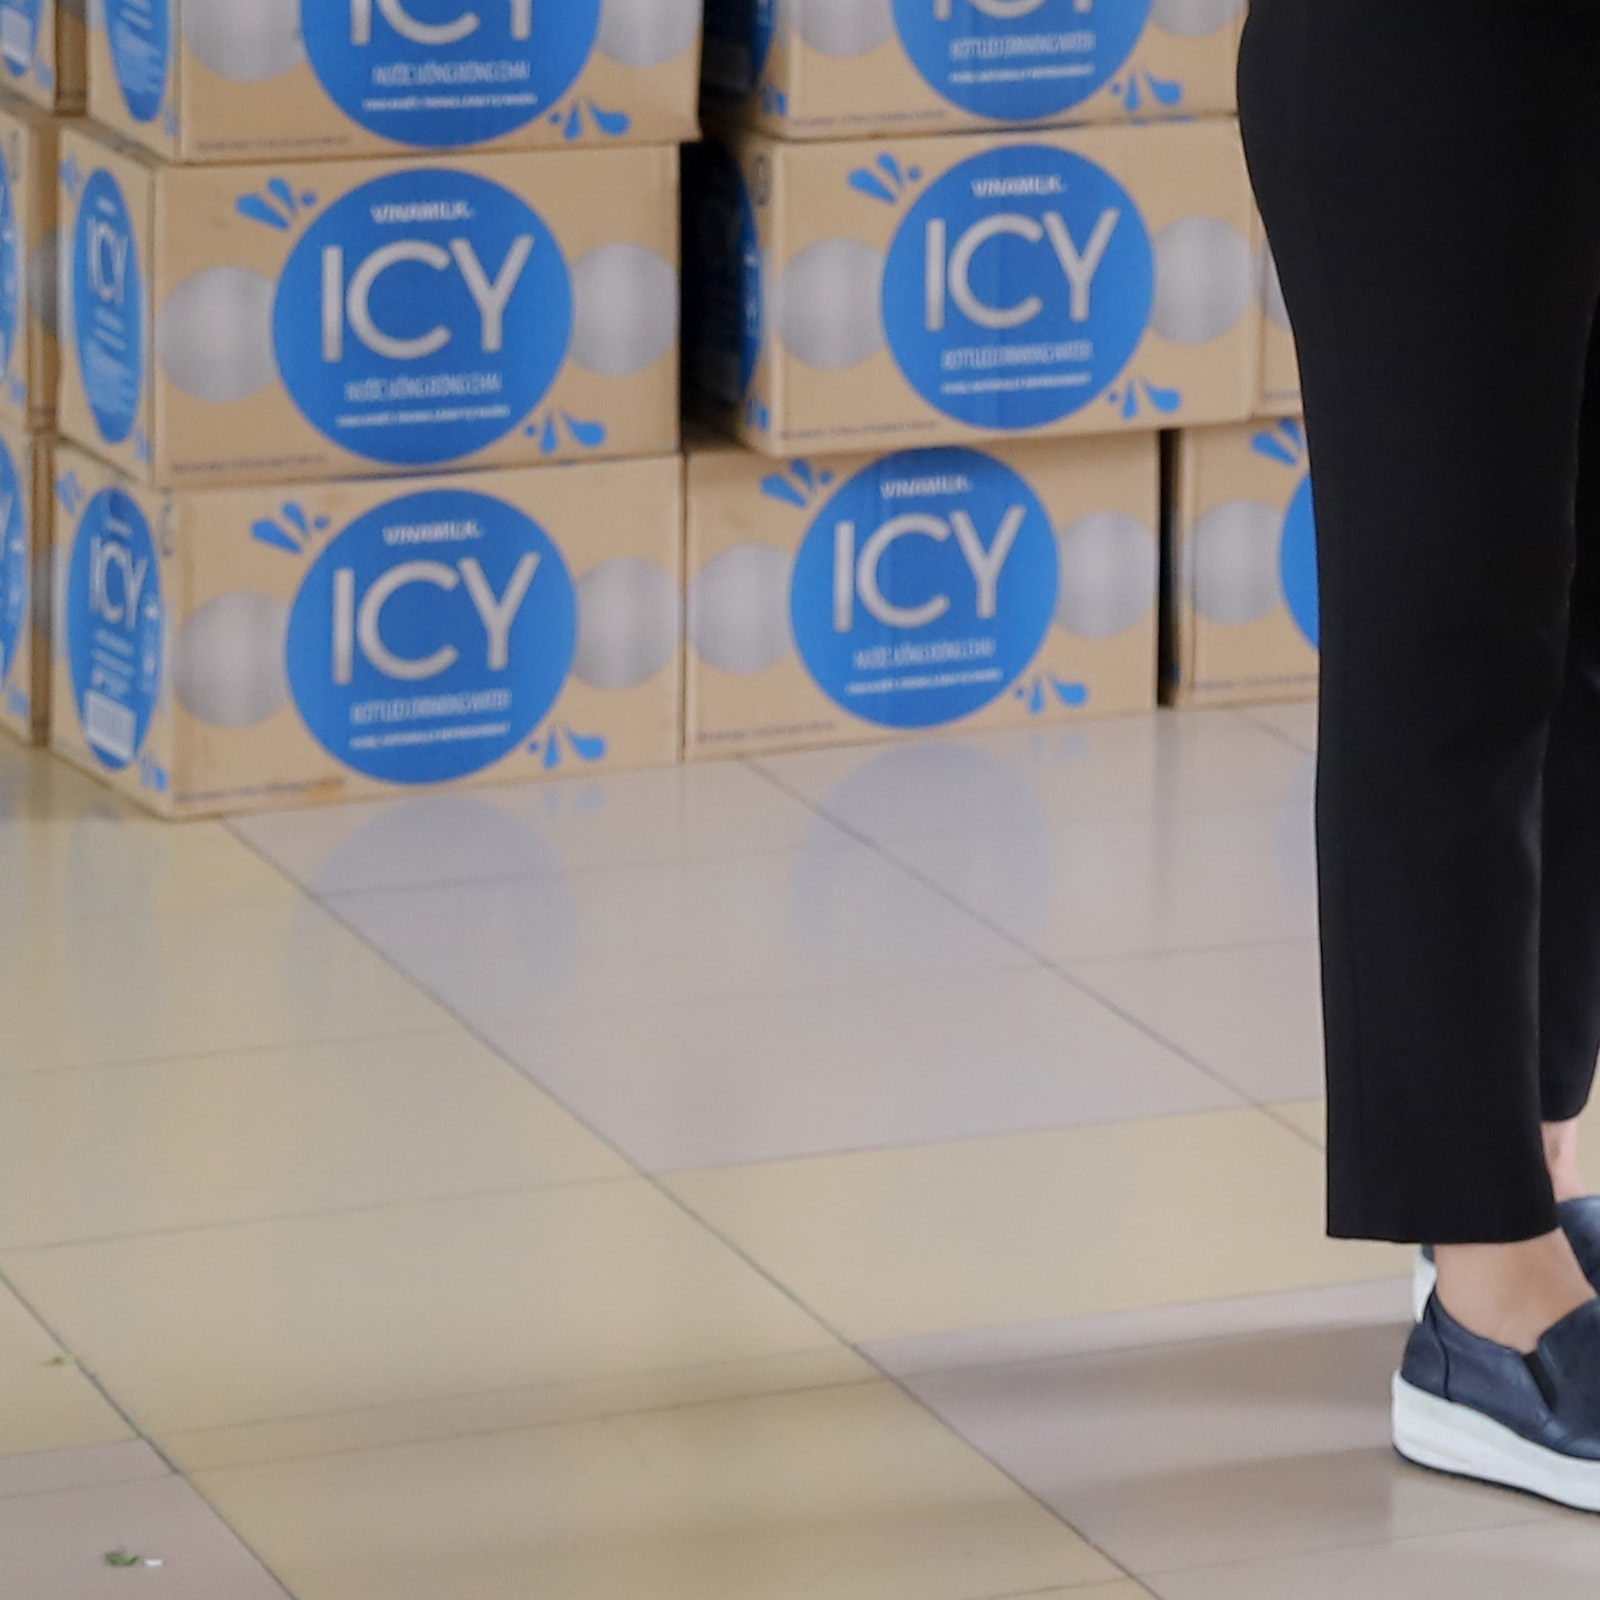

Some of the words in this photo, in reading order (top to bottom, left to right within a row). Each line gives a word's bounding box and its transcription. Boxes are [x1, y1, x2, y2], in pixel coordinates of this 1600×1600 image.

[371, 201, 472, 223] VINAMILK
[926, 208, 1119, 331] ICY
[322, 235, 533, 361] ICY
[383, 521, 480, 544] VINAMILK
[834, 506, 1025, 632] ICY
[333, 553, 540, 684] ICY
